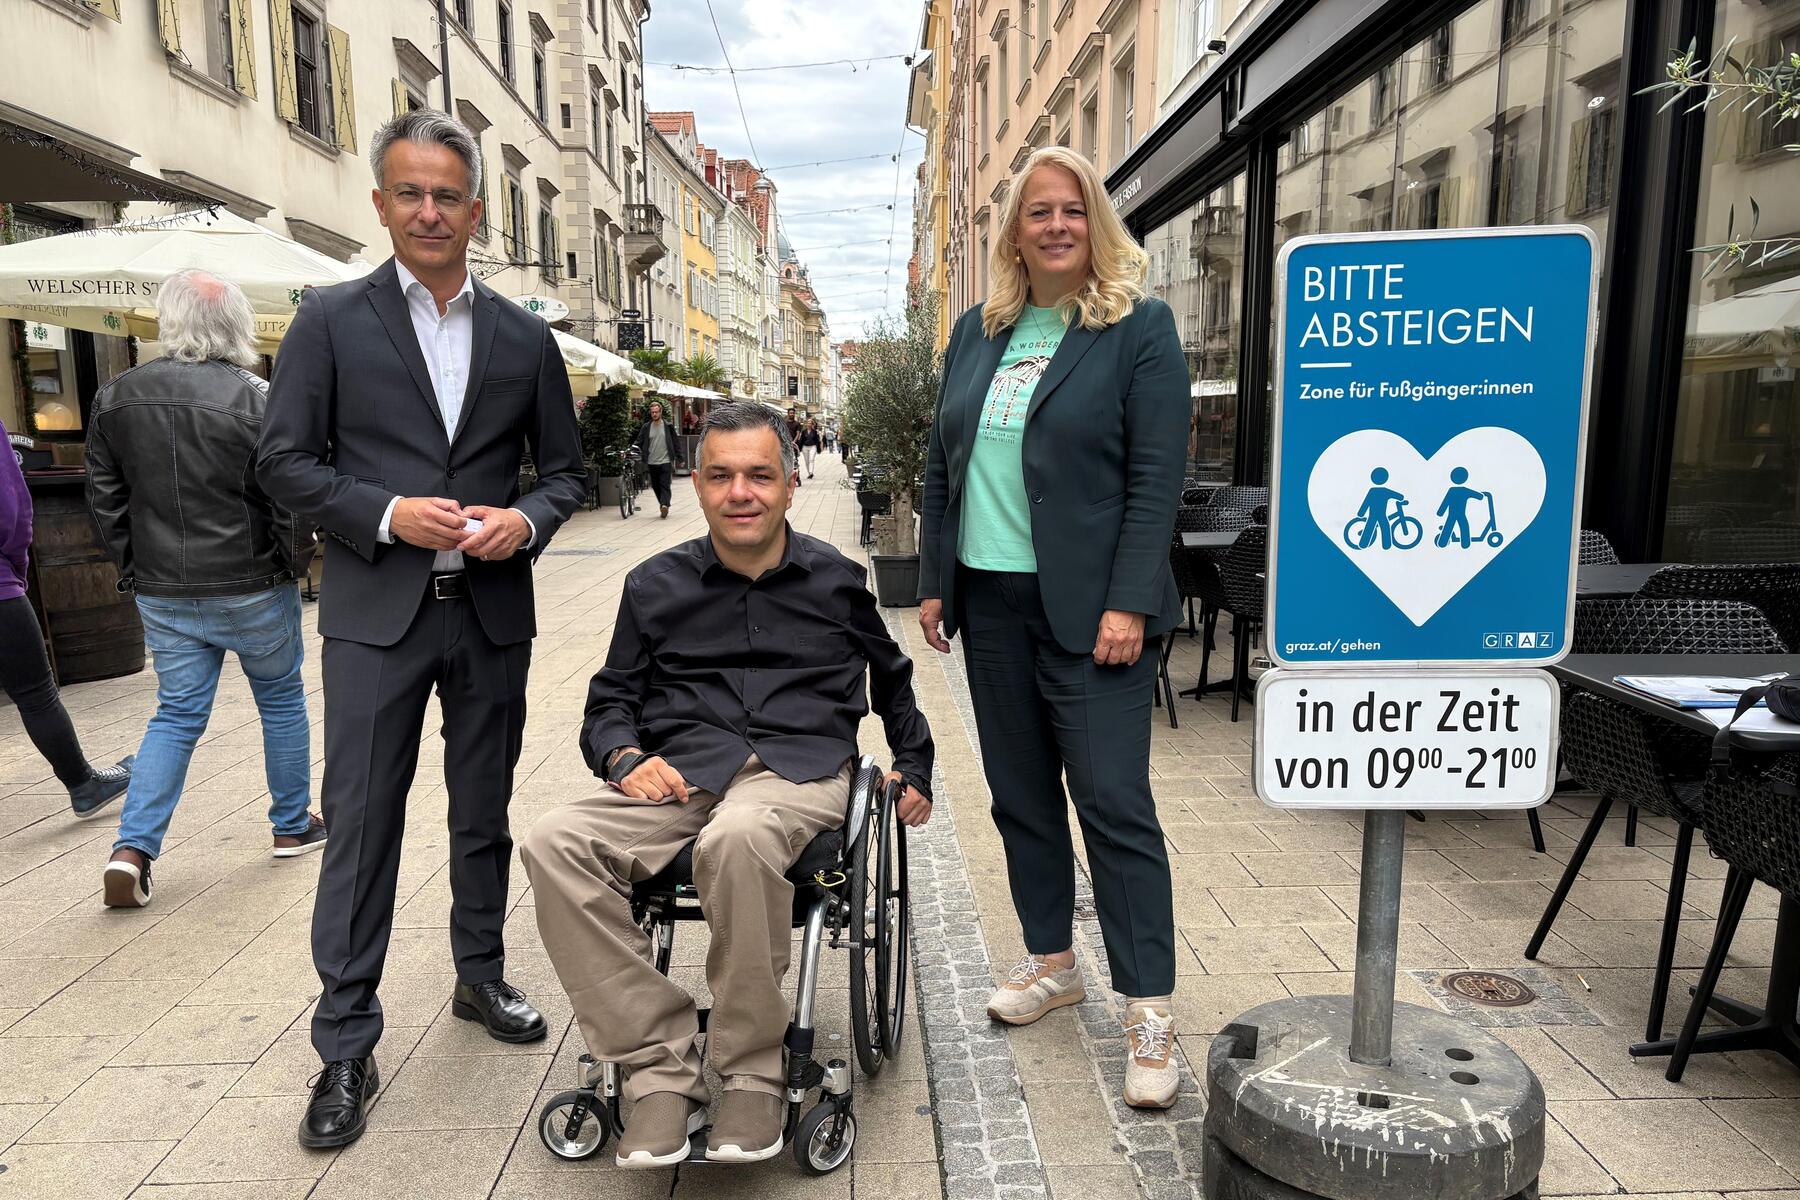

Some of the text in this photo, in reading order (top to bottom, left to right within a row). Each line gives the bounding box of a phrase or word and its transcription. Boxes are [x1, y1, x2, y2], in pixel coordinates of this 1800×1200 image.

[1122, 176, 1142, 203] FASHION
[27, 279, 137, 296] WELSCHER
[1304, 263, 1404, 302] BITTE
[1299, 306, 1534, 348] ABSTEIGEN
[1299, 379, 1534, 402] Zone für Fußgänger:innen
[1285, 632, 1552, 654] graz.at/gehen GRAZ
[1296, 688, 1520, 733] in der Zeit
[1275, 757, 1349, 789] von
